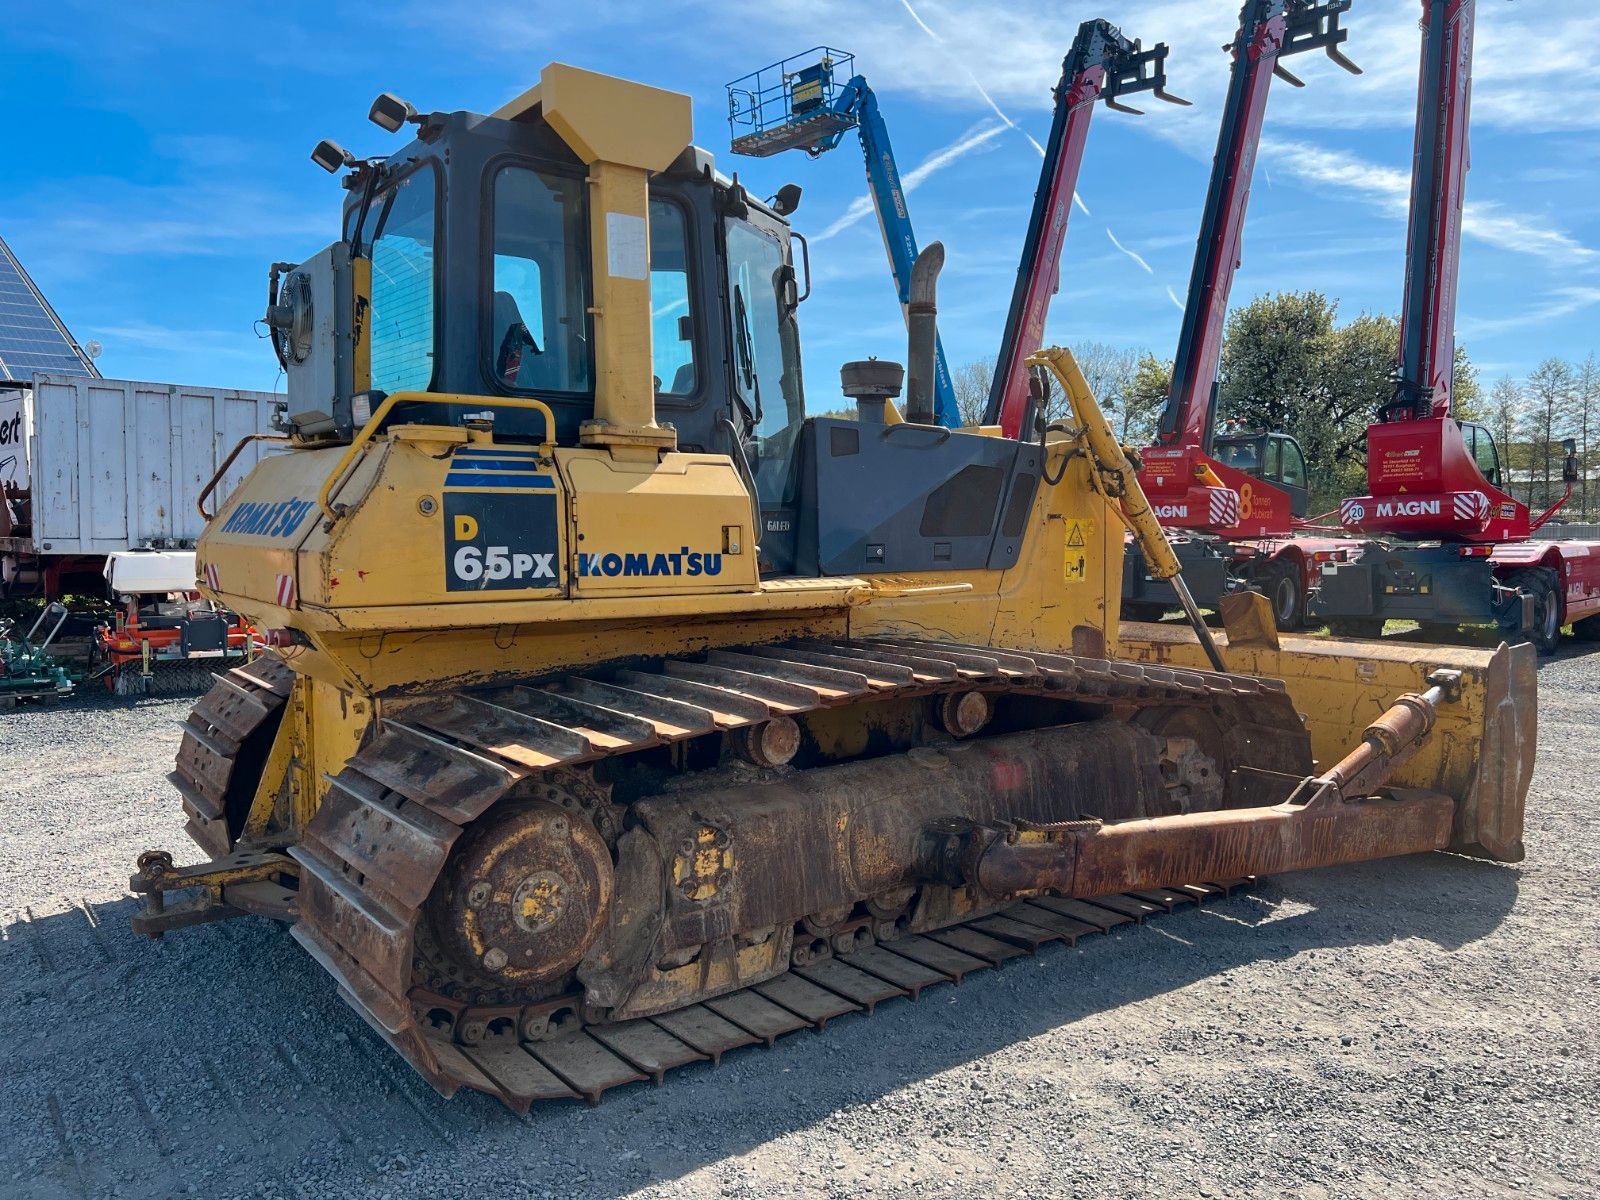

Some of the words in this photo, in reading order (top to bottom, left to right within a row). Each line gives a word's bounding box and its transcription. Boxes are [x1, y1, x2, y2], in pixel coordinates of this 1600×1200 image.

[1154, 505, 1188, 518] AGNI
[1240, 482, 1252, 520] 8
[1351, 507, 1363, 518] 20
[1376, 500, 1441, 517] MAGNI
[221, 496, 316, 537] KOMATSU
[454, 514, 479, 541] D
[454, 546, 556, 581] 65PX
[578, 547, 722, 577] KOMATSU
